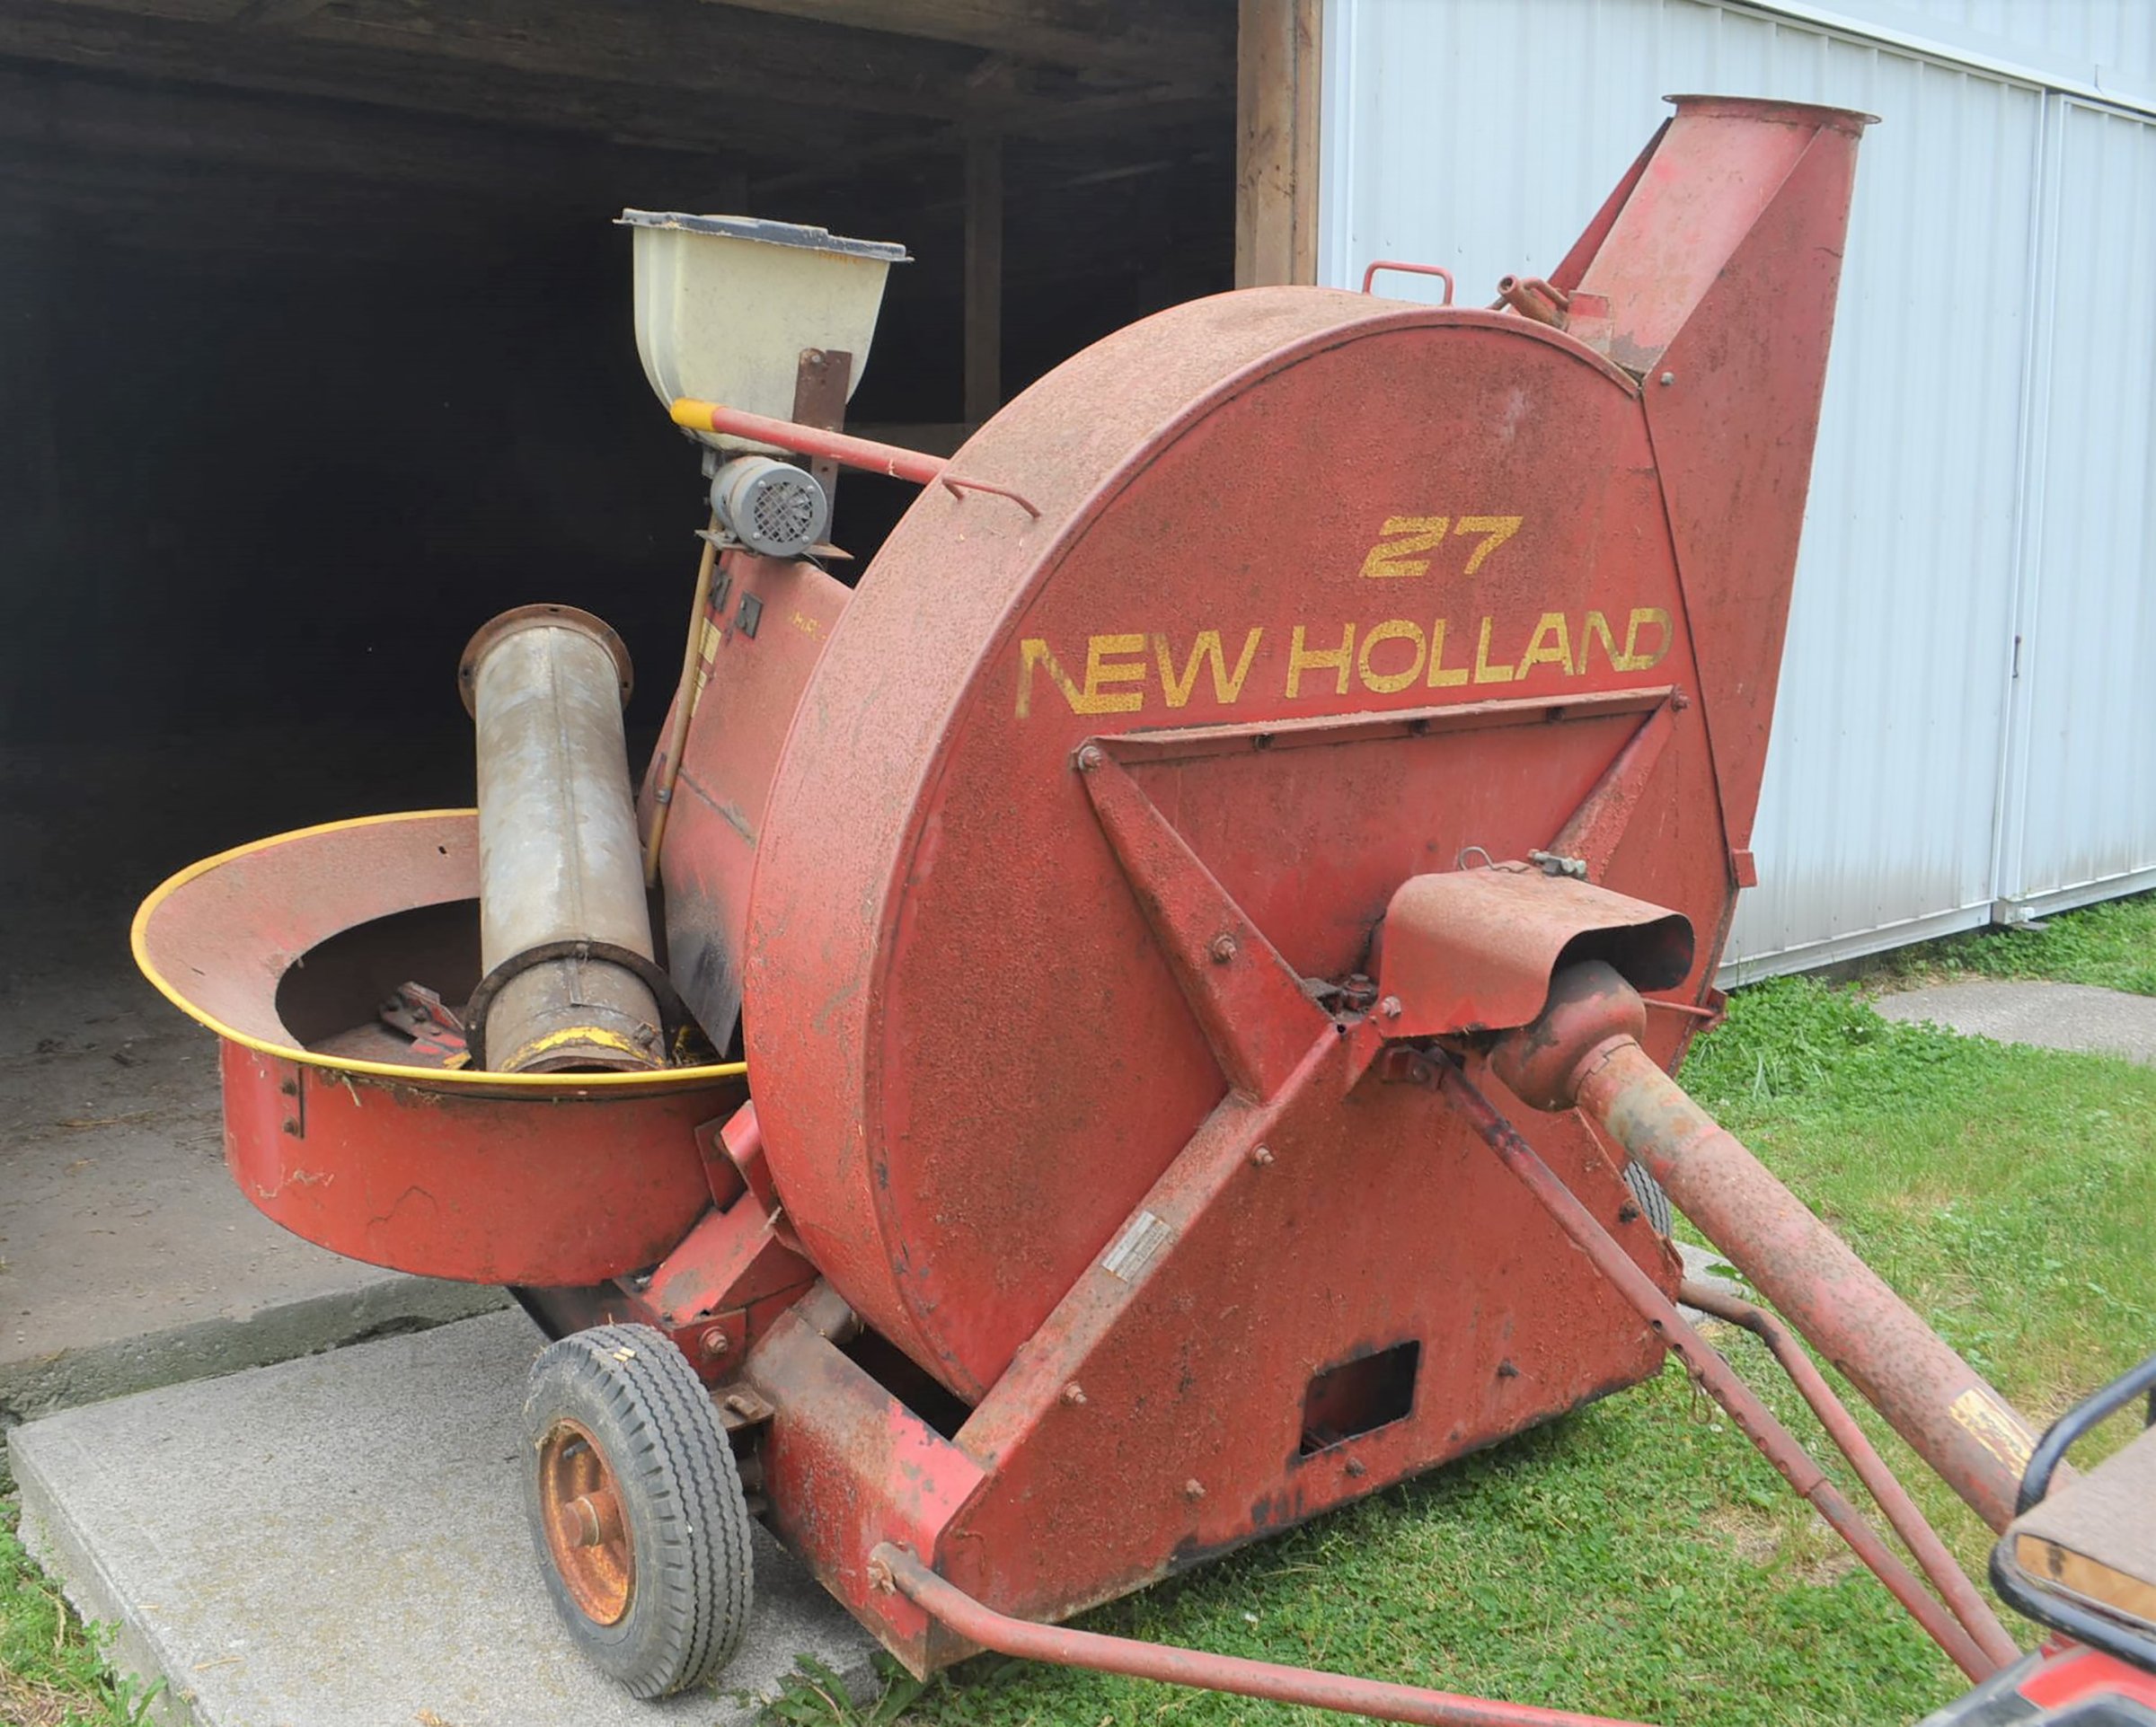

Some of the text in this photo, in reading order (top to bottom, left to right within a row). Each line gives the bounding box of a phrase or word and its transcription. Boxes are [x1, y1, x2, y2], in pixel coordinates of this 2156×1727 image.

[1359, 515, 1522, 577] 27
[1016, 608, 1672, 717] NEW HOLLAND
